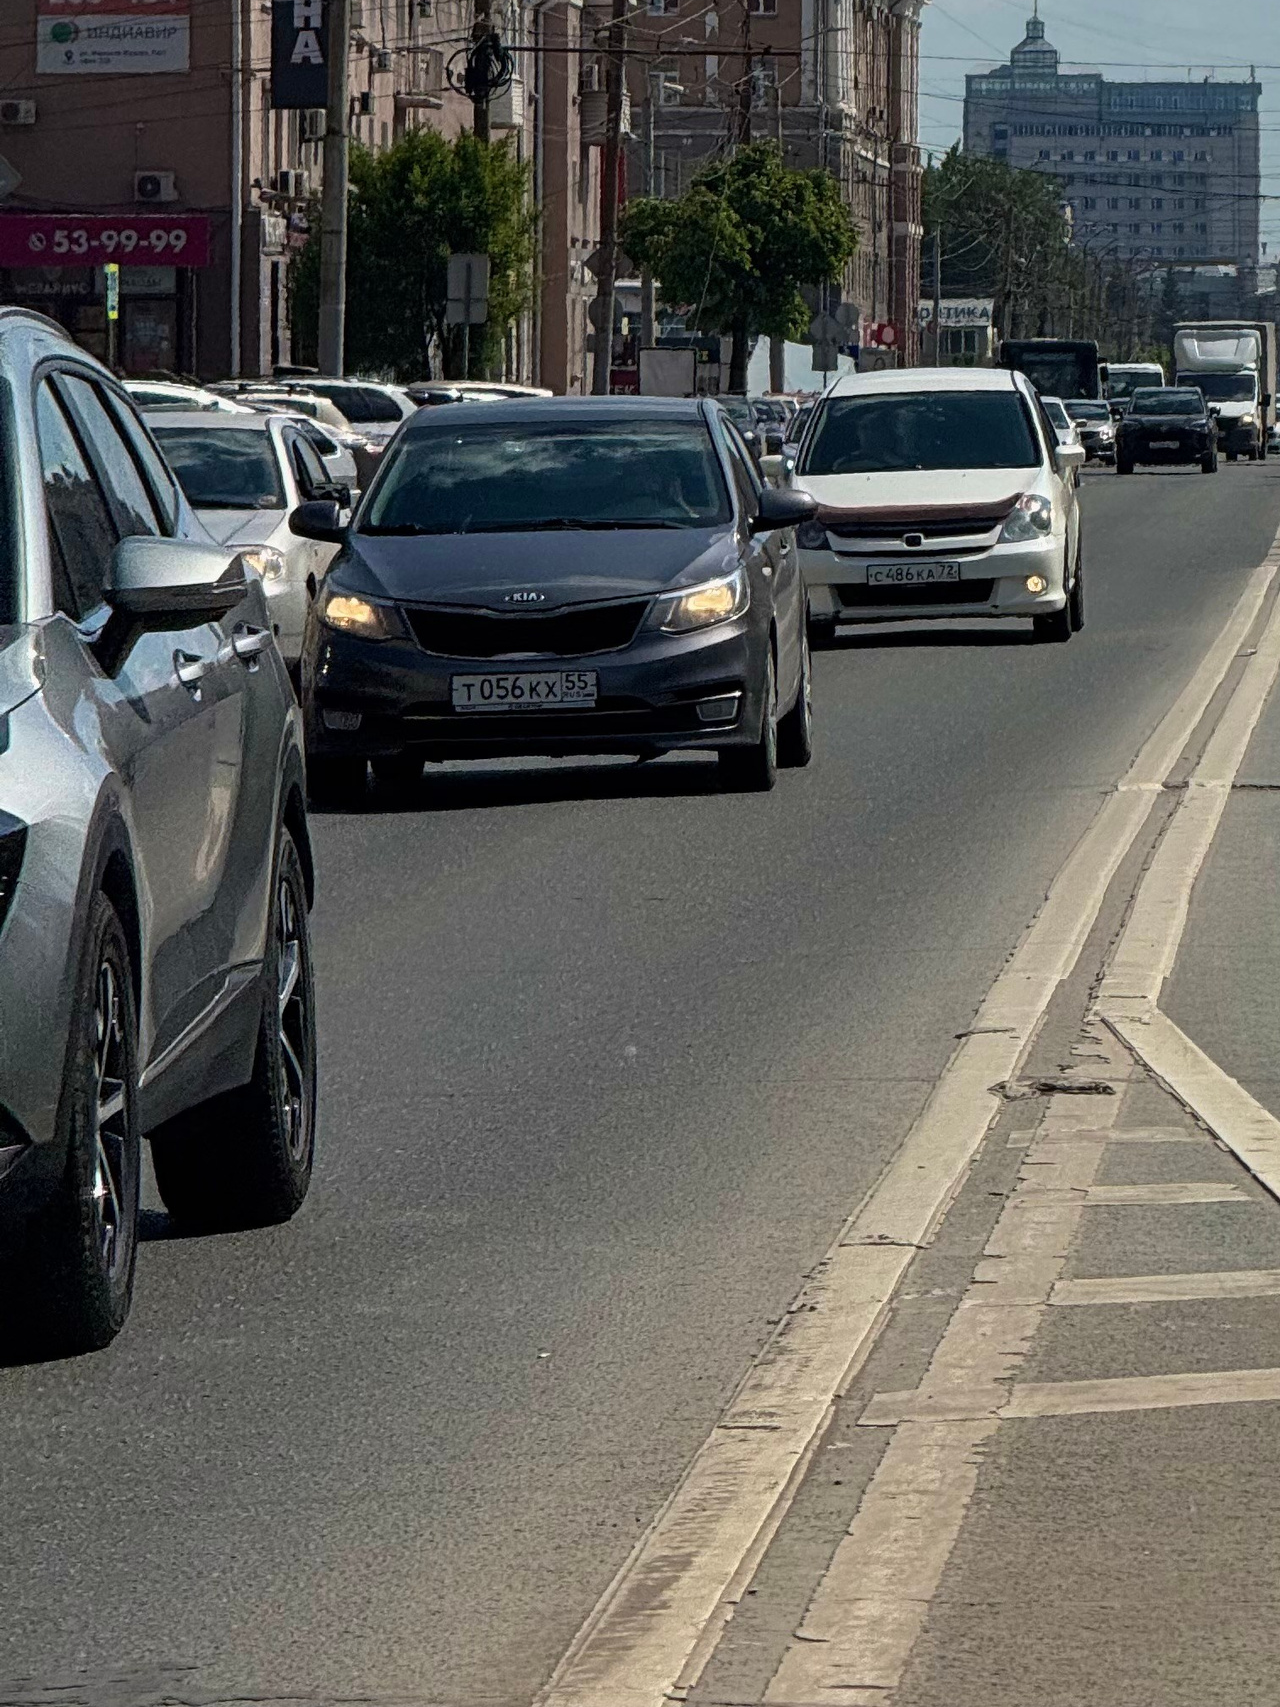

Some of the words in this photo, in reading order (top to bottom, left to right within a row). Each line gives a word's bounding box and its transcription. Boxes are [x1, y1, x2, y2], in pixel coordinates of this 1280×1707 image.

[52, 229, 188, 254] 53-99-99
[462, 677, 558, 702] Т056КХ
[565, 673, 588, 691] 55
